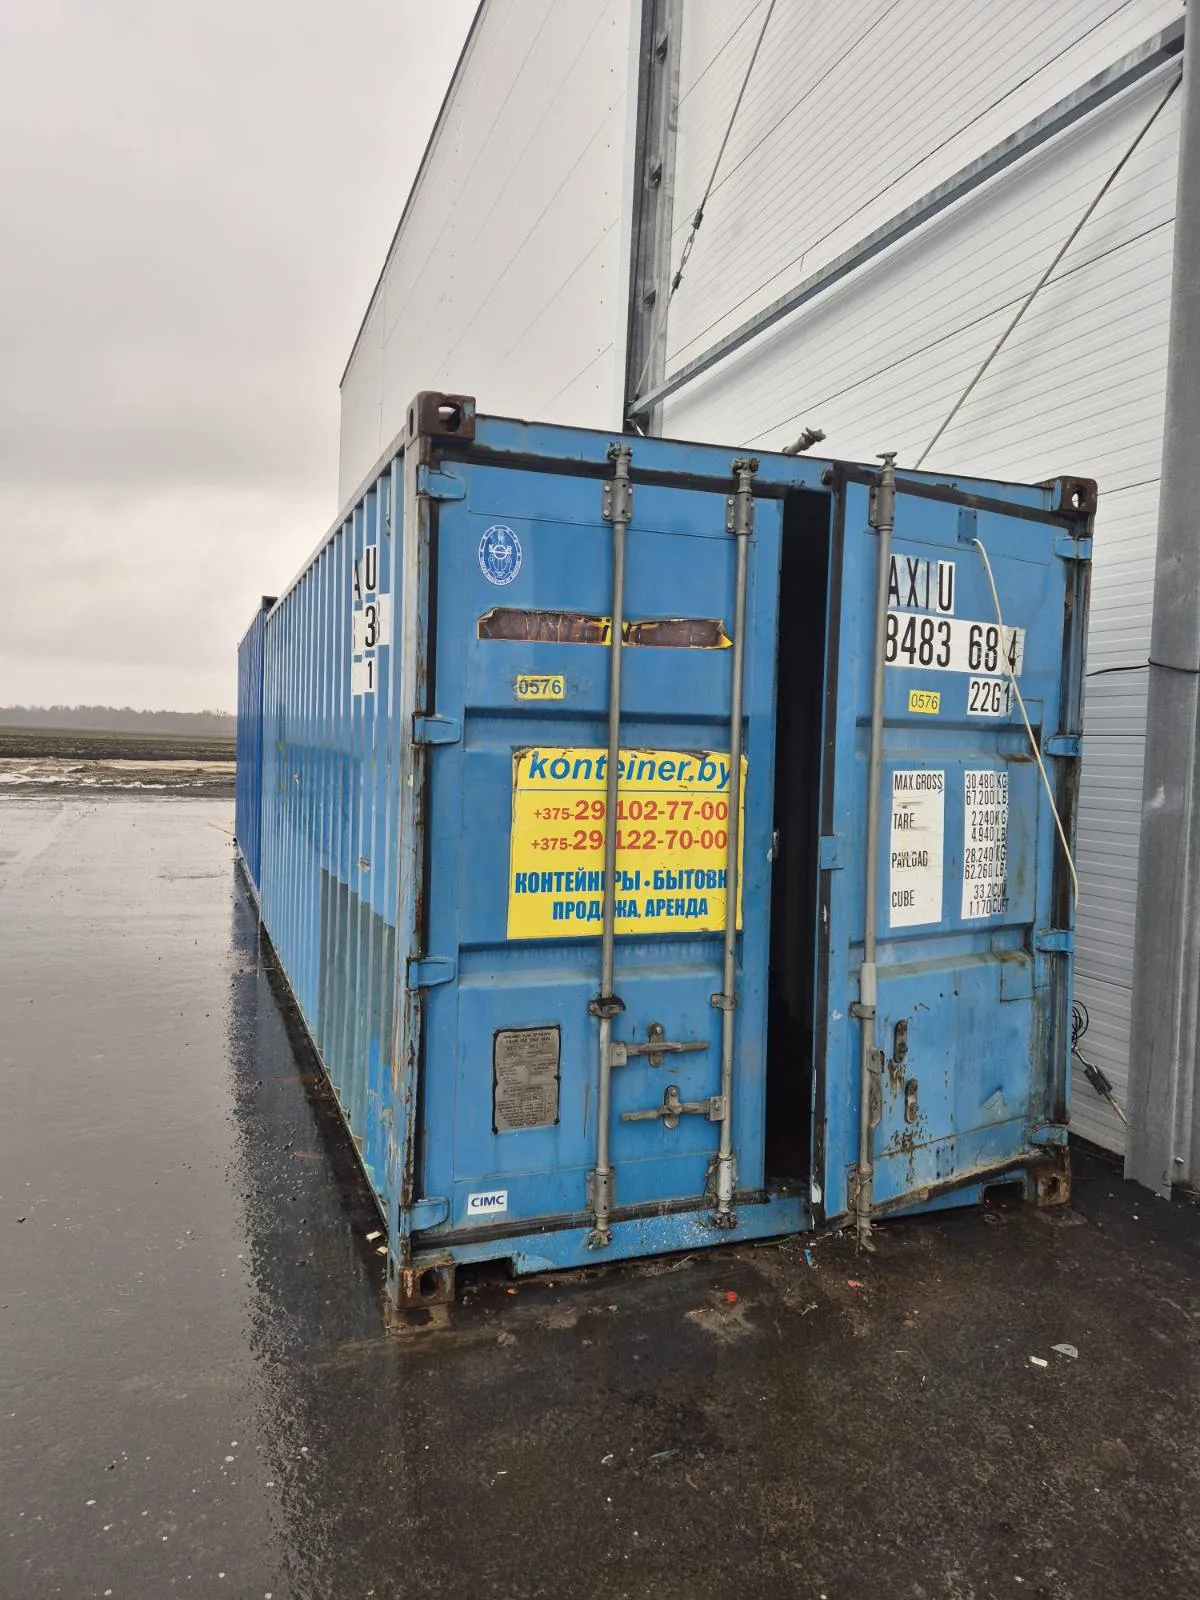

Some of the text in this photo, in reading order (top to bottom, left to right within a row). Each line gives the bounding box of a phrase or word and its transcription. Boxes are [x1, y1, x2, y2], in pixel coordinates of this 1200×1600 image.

[887, 555, 953, 611] AXIU
[885, 614, 951, 667] 8483
[518, 679, 562, 695] 0576
[970, 681, 1011, 713] 22G1
[911, 693, 938, 710] 0576
[528, 751, 731, 789] konteiner.by
[966, 790, 995, 805] 67.200
[533, 799, 728, 821] +375-29102-77-00
[893, 812, 916, 829] TARE
[971, 810, 994, 826] 2.240
[531, 829, 728, 851] +375-29122-70-00
[971, 827, 994, 842] 4.940
[892, 850, 928, 868] PAYLOAD
[965, 847, 993, 863] 28.240
[514, 867, 641, 893] КОНТЕЙНРЫ
[965, 863, 992, 879] 62.260
[892, 889, 915, 907] CUBE
[552, 897, 709, 921] ПРОДЖА, АРЕНДА
[471, 1195, 505, 1207] CIMC
